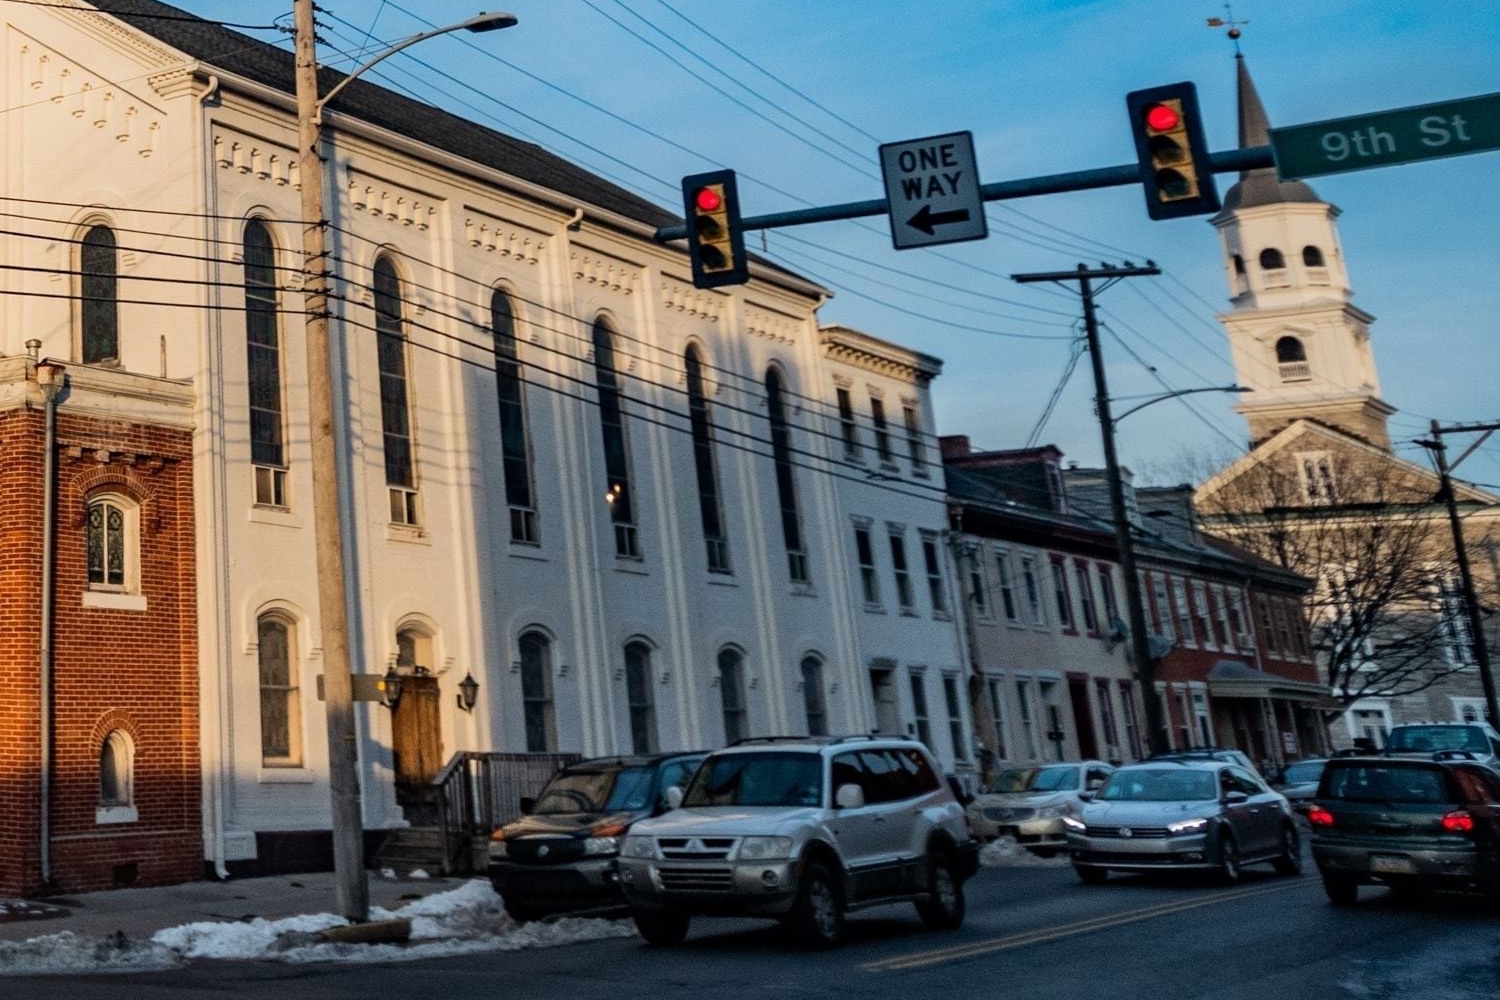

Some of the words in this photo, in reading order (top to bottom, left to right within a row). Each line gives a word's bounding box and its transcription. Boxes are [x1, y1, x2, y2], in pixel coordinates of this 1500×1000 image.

[1321, 125, 1396, 162] 9th
[1418, 114, 1471, 147] St
[899, 143, 958, 173] ONE
[901, 171, 962, 201] WAY
